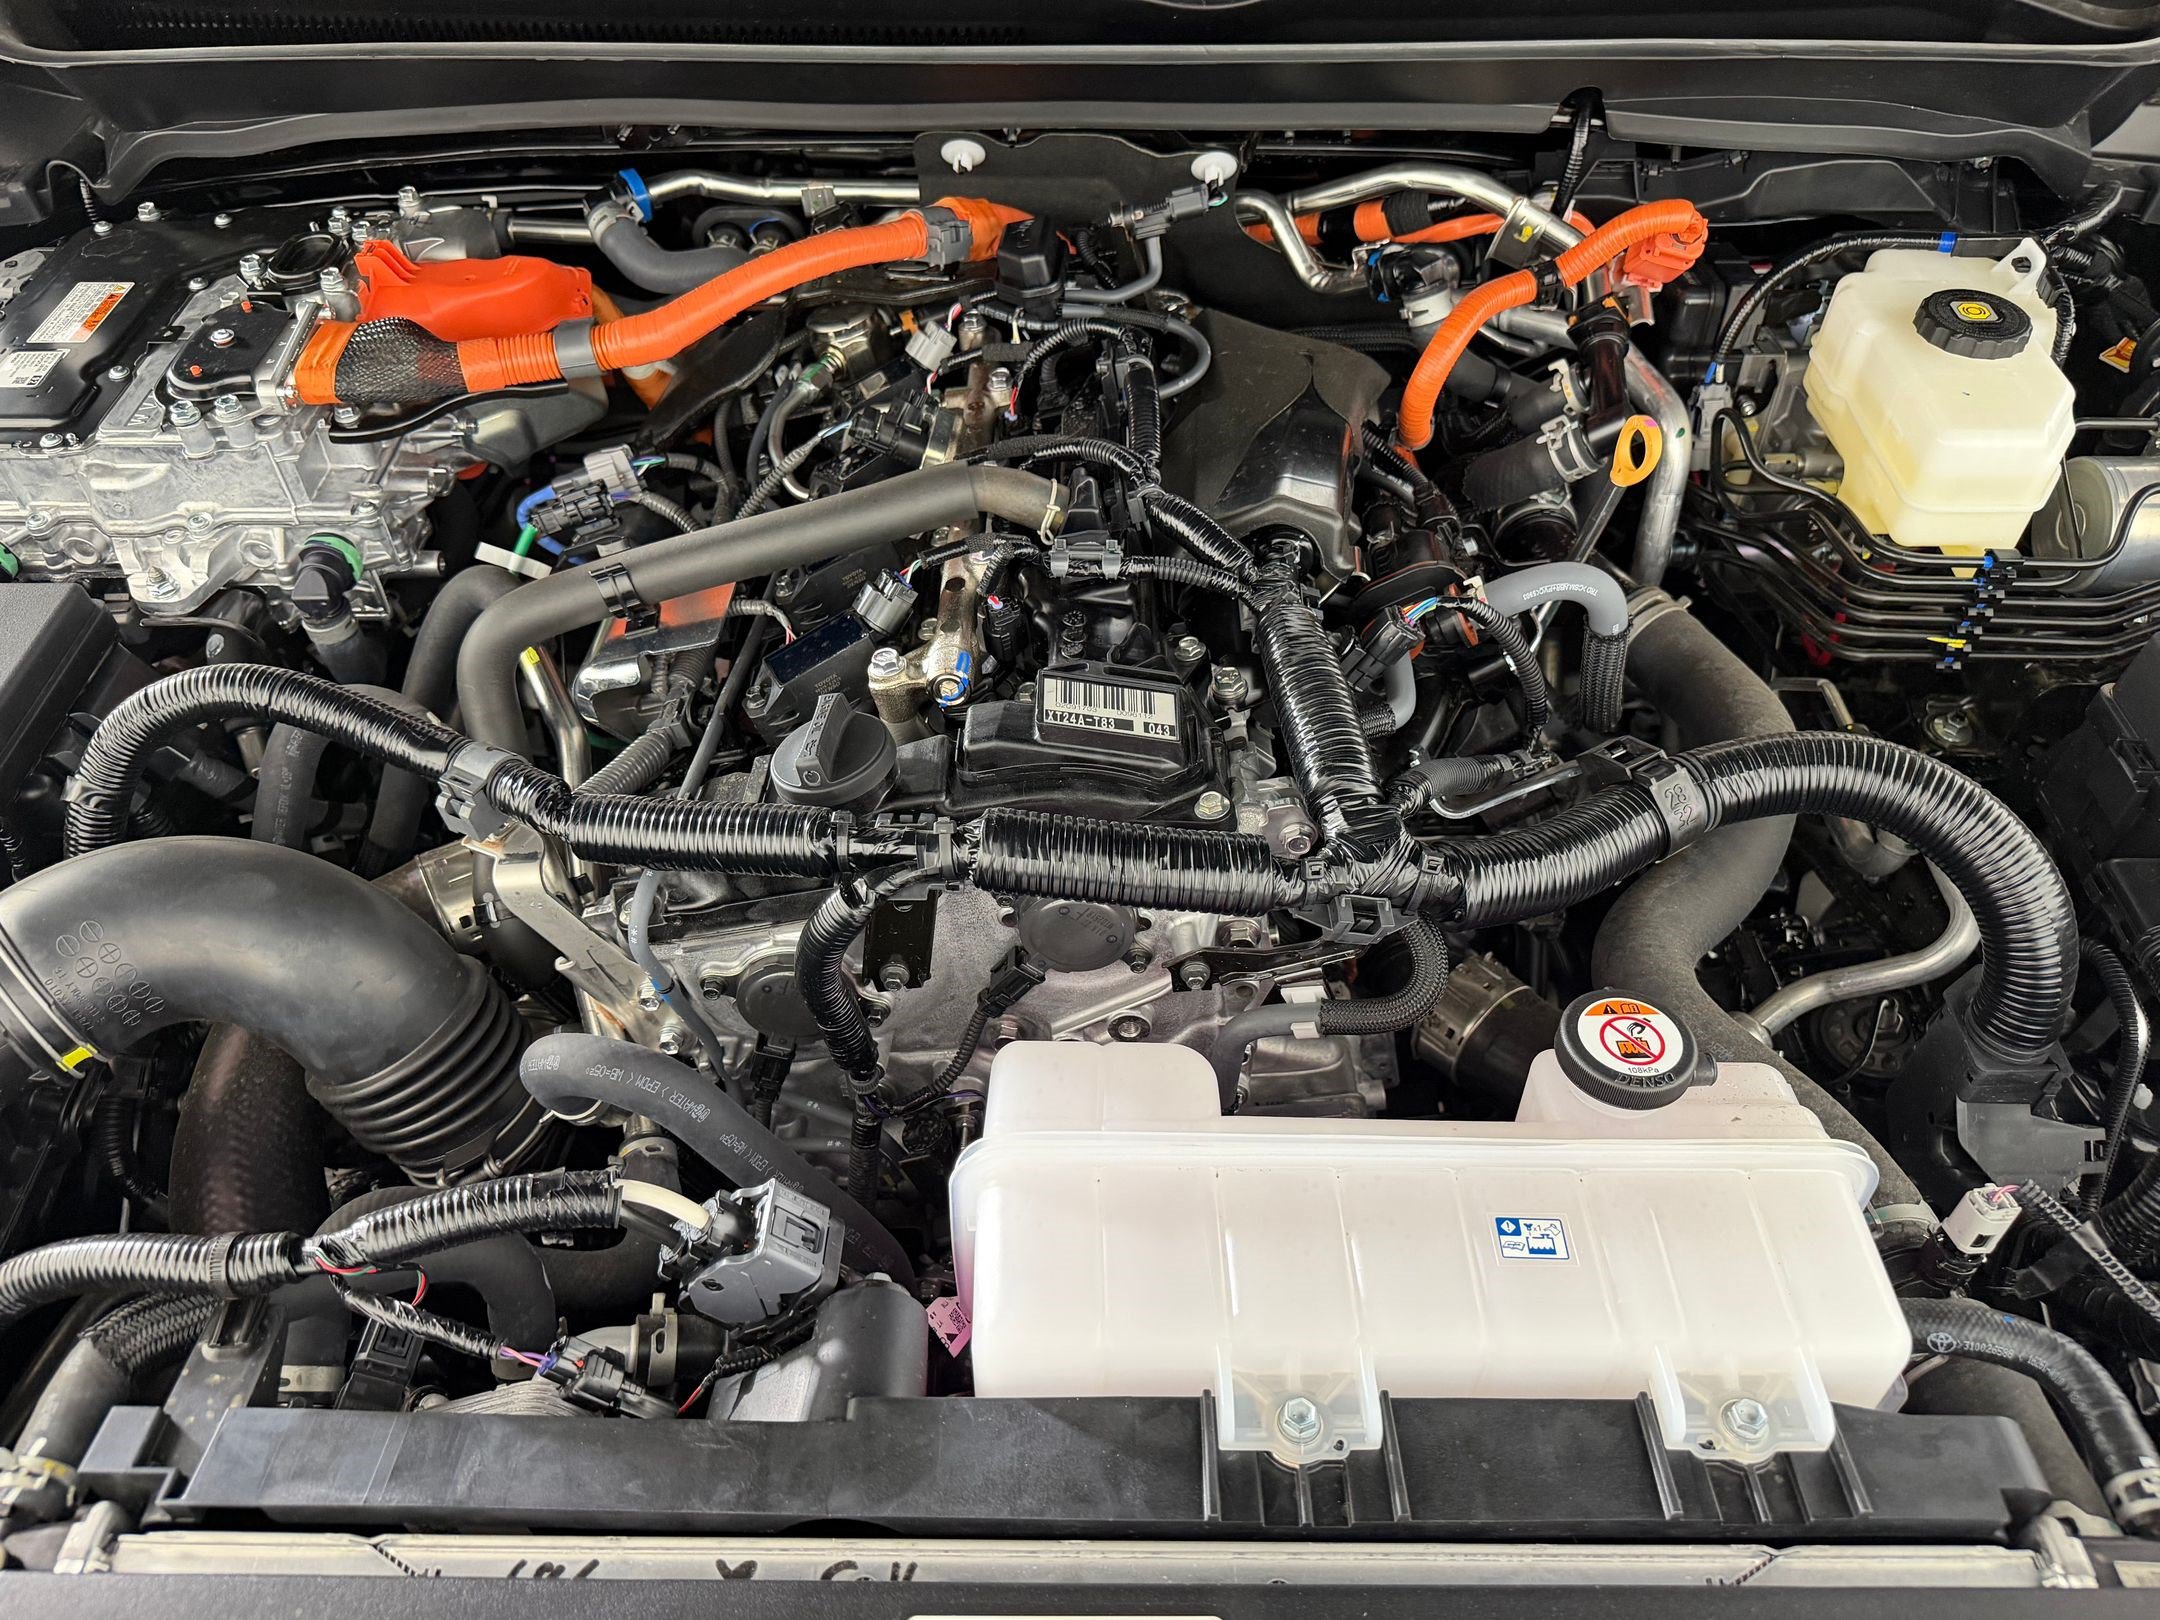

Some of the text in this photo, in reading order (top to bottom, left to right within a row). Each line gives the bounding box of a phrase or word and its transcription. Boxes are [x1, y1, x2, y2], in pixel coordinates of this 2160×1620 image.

[1047, 709, 1116, 729] XT24A-T83
[1148, 723, 1170, 736] 043
[1664, 783, 1687, 810] 28
[1614, 1071, 1676, 1088] DENSO
[1628, 1066, 1660, 1074] 108kPa
[634, 1074, 661, 1094] EPDM
[667, 1089, 697, 1114] WATER
